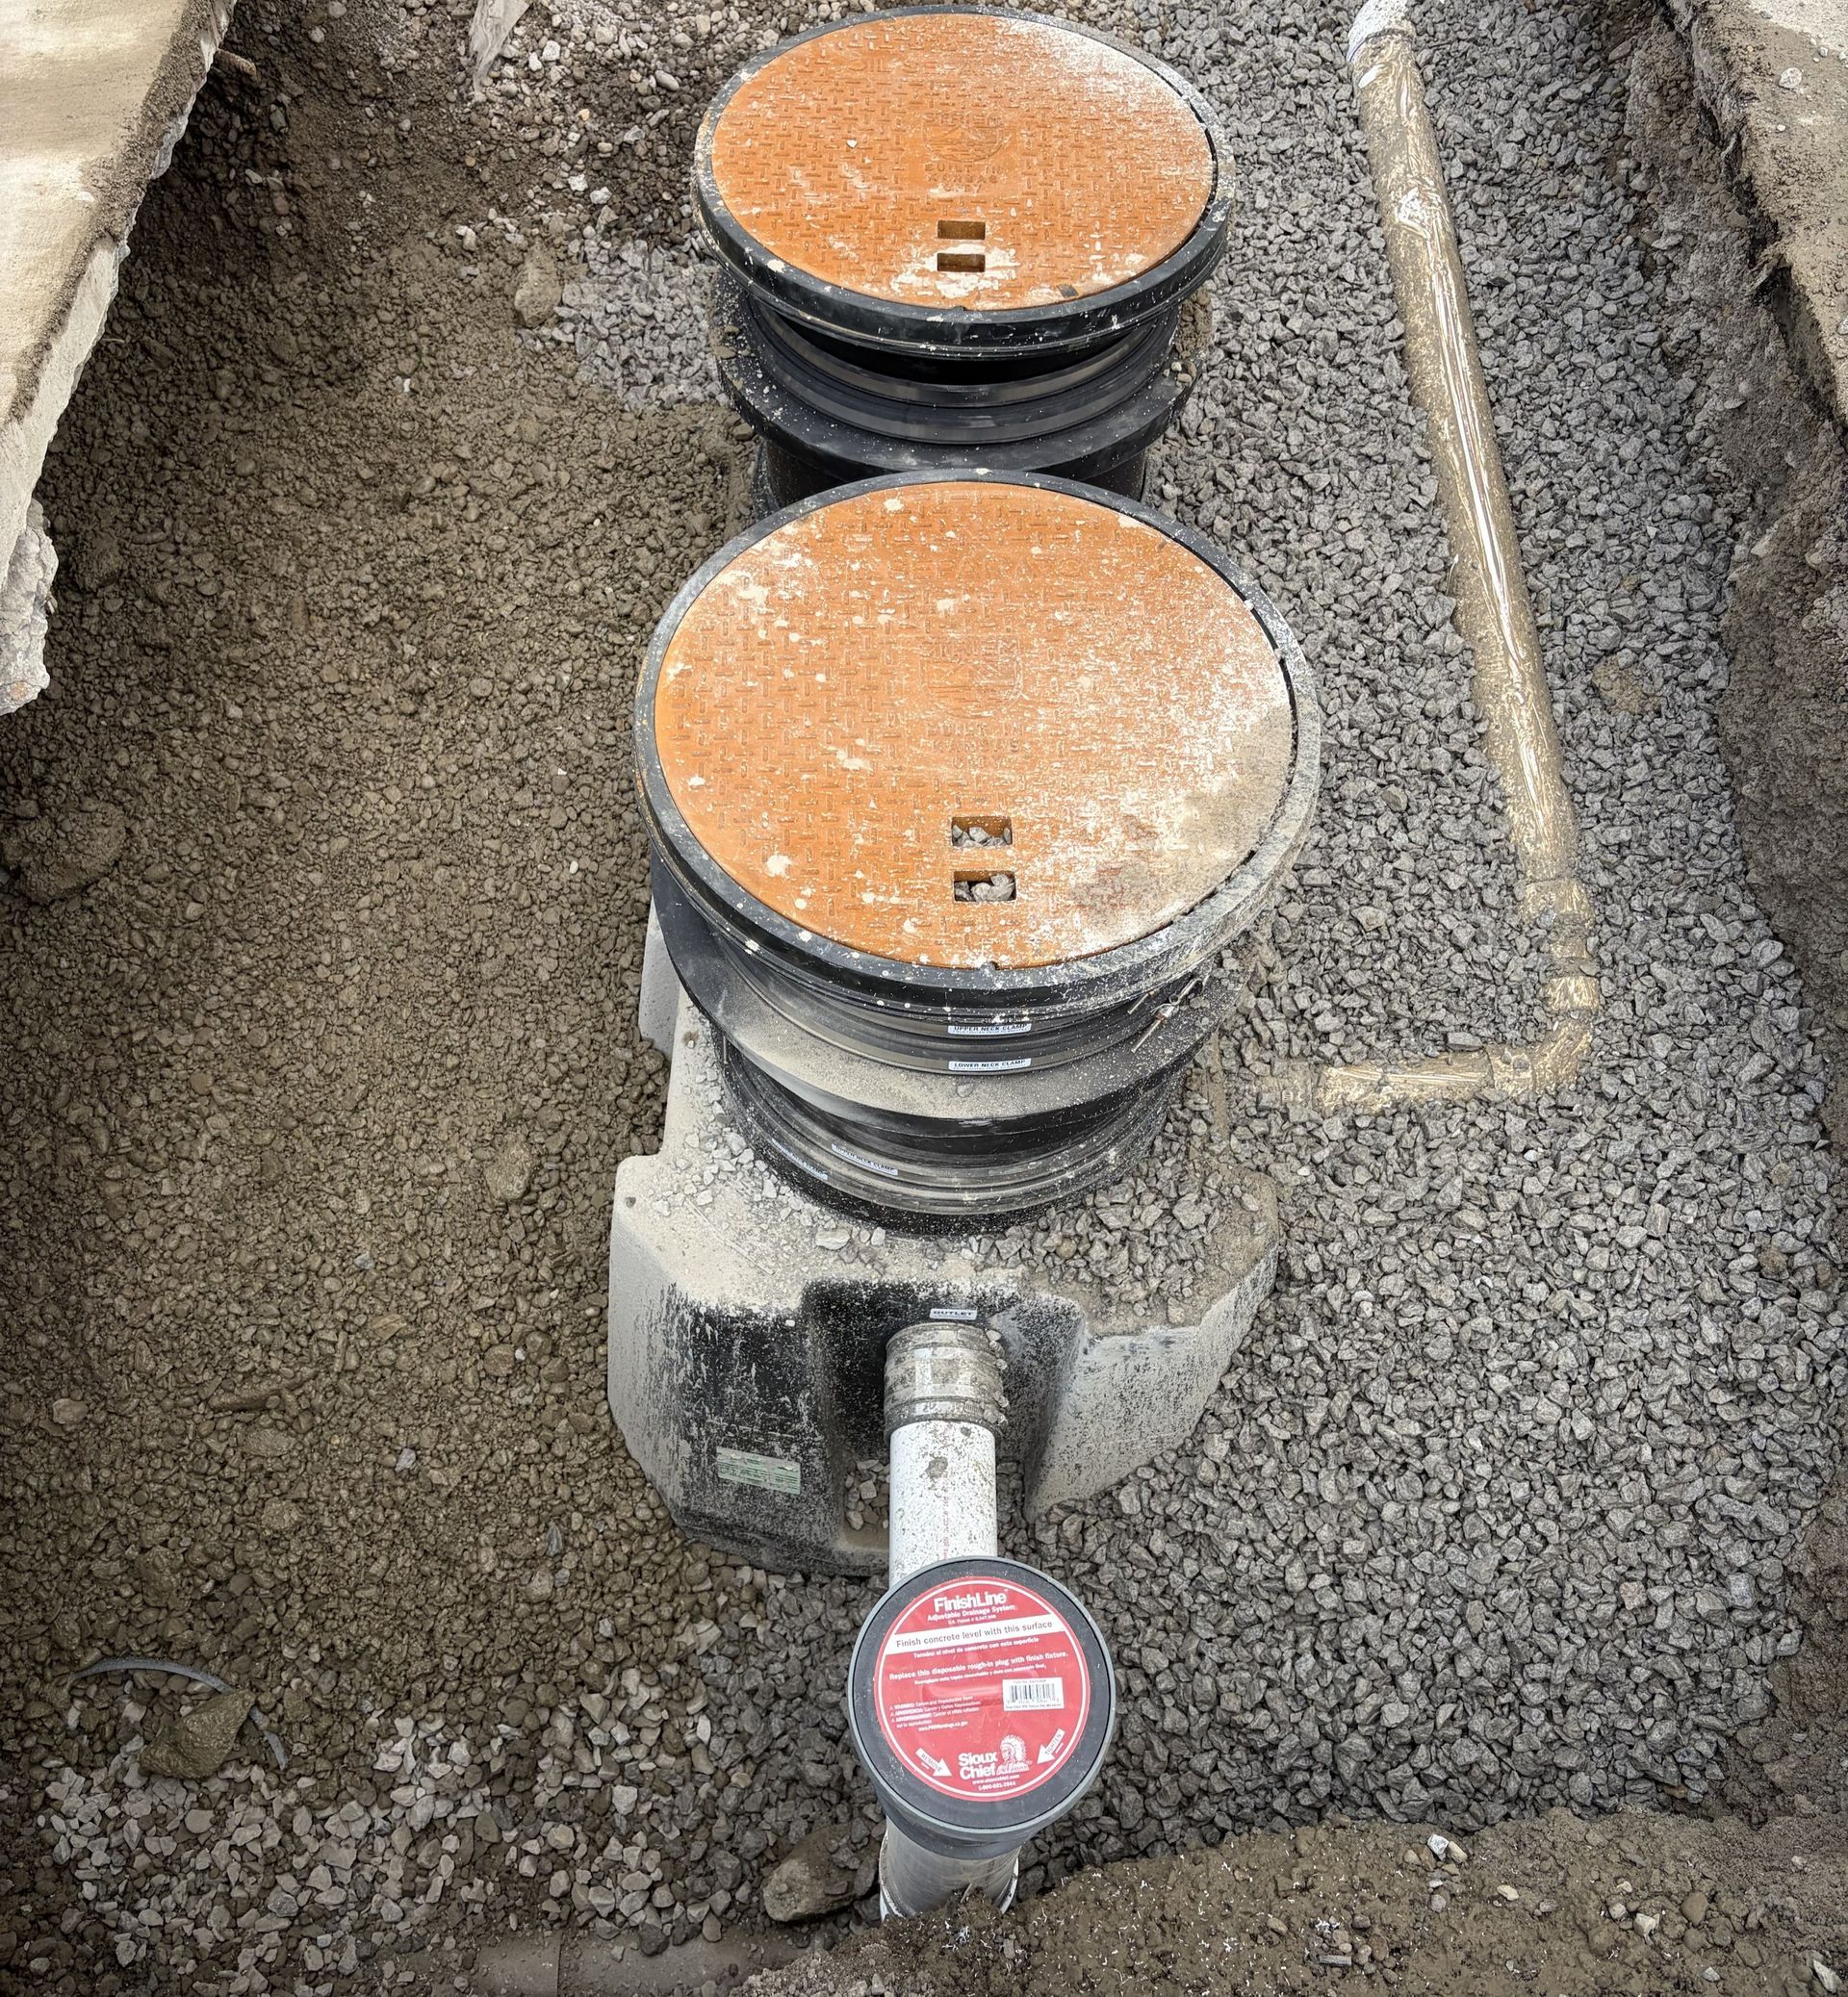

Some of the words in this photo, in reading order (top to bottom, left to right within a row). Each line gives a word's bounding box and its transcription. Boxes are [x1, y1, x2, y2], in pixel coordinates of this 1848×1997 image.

[934, 1591, 1007, 1613] FinishLine
[927, 1610, 961, 1622] Adjustable
[962, 1607, 990, 1617] Drainage
[991, 1604, 1015, 1614] System
[896, 1638, 921, 1648] Finish
[924, 1632, 961, 1644] concrete
[962, 1629, 982, 1640] level
[984, 1626, 1003, 1636] with
[1004, 1624, 1020, 1633] this
[1022, 1621, 1053, 1632] surface
[889, 1671, 916, 1680] Replace
[931, 1664, 966, 1676] disposable
[994, 1658, 1010, 1668] plug
[1026, 1653, 1044, 1662] finish
[958, 1751, 998, 1767] Sioux
[960, 1762, 996, 1780] Chief
